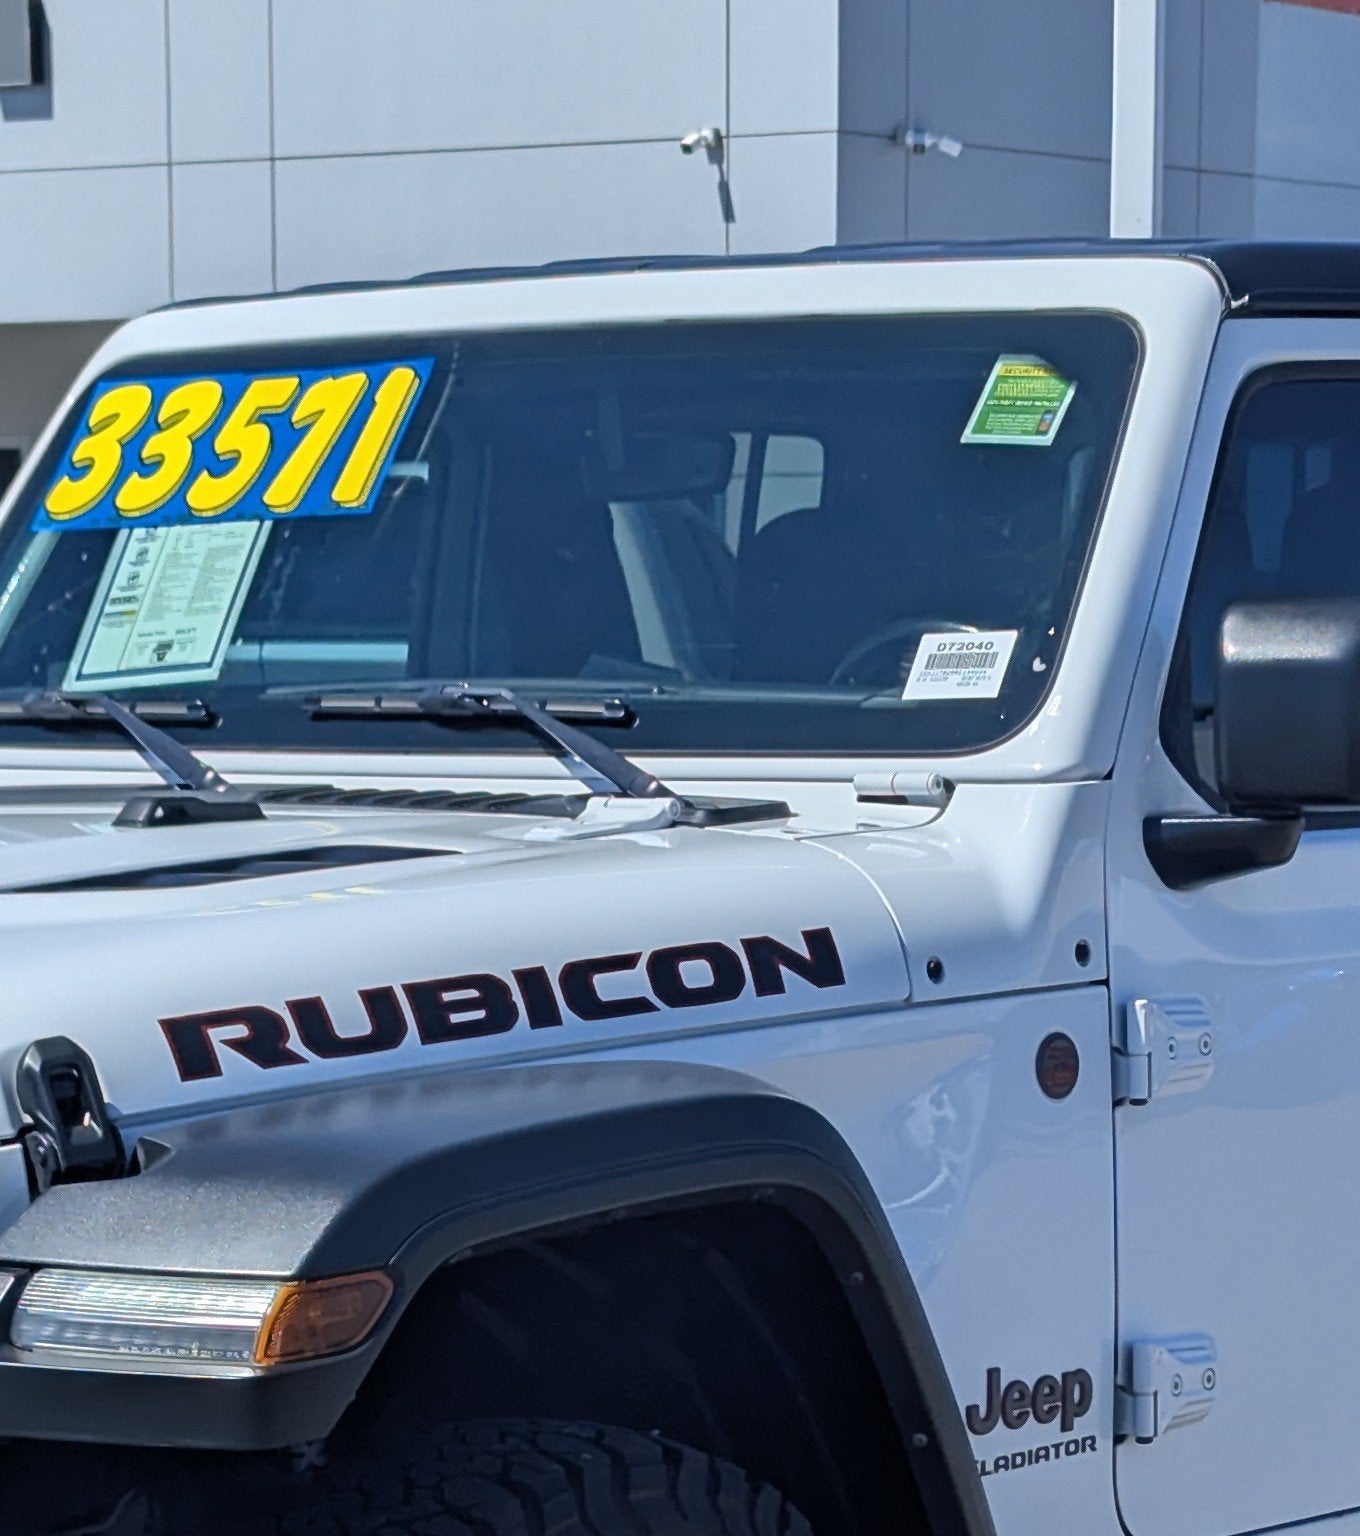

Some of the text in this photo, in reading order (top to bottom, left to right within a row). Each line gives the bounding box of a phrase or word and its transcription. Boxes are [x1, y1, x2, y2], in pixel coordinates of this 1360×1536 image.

[45, 367, 421, 521] 33571
[157, 926, 847, 1083] RUBICON
[965, 1366, 1094, 1436] Jeep
